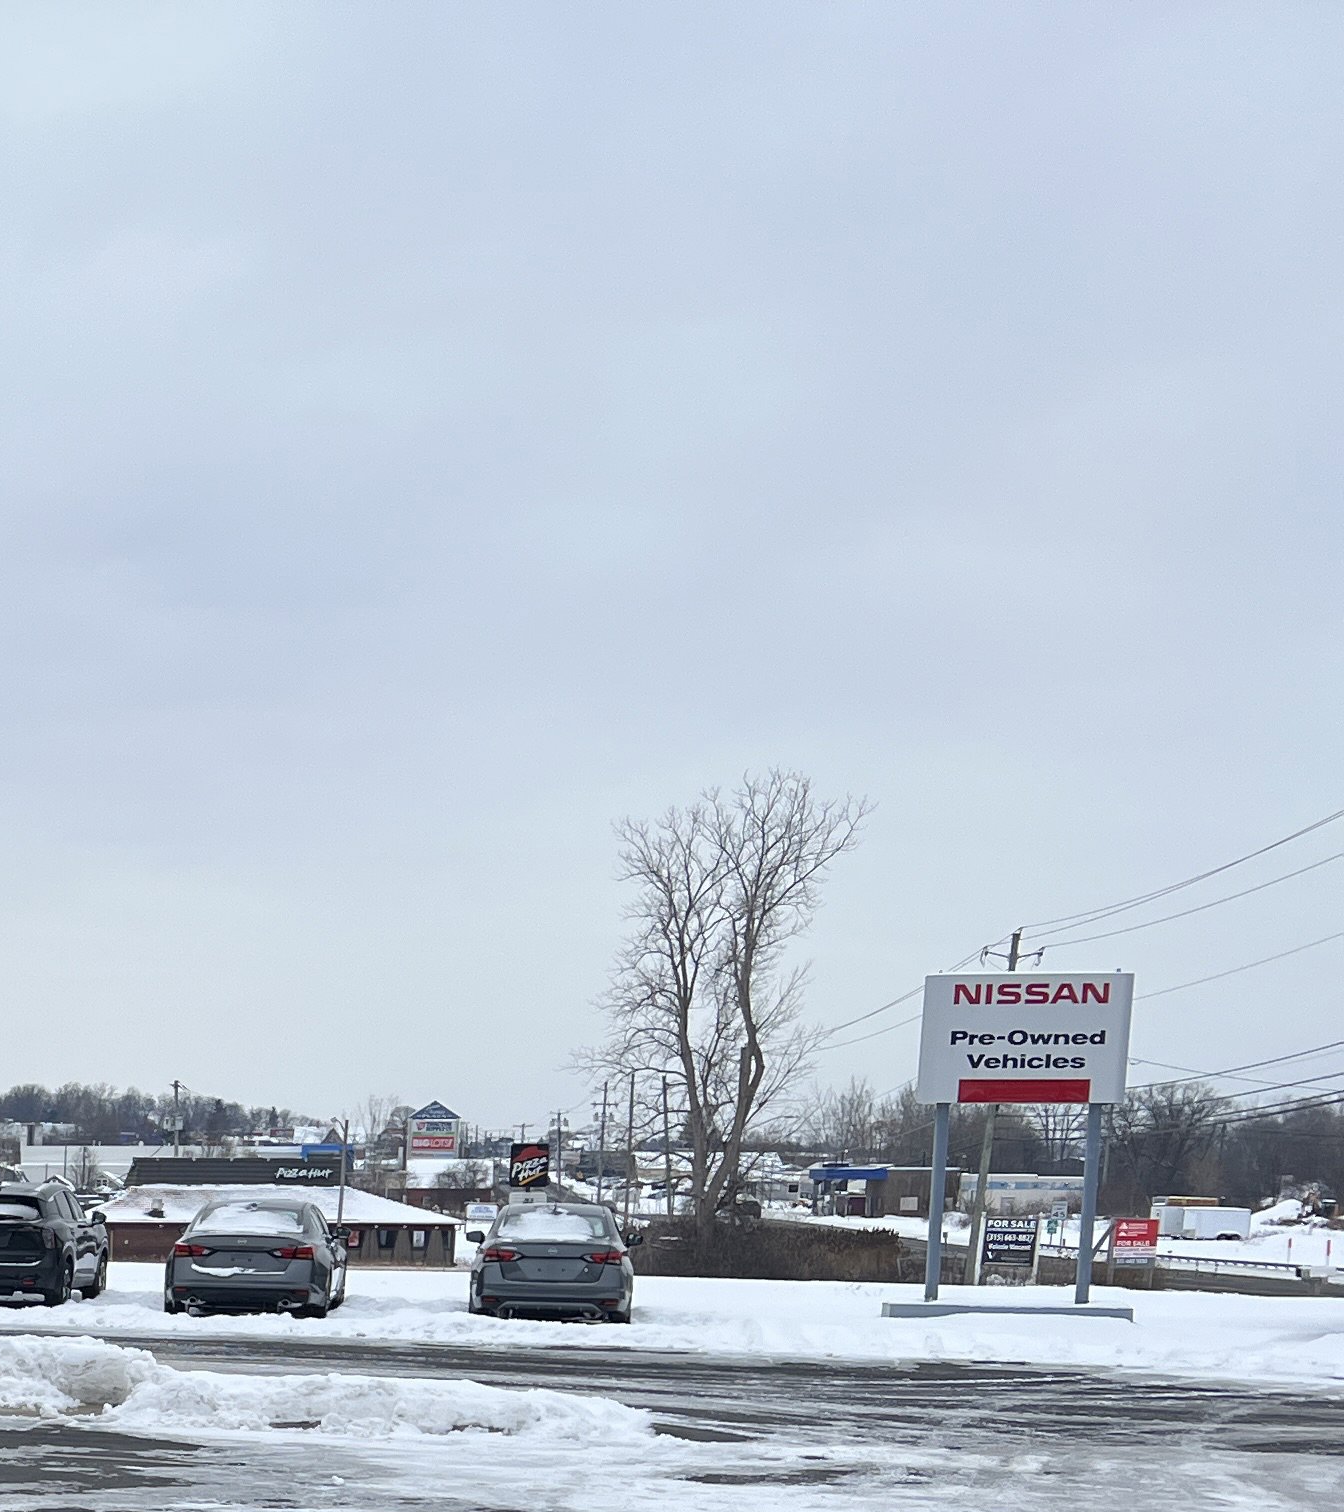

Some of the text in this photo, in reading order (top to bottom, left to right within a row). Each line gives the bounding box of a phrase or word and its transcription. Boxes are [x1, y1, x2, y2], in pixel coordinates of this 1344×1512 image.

[953, 982, 1110, 1005] NISSAN
[949, 1029, 1106, 1046] Pre-Owned
[967, 1053, 1086, 1069] Vehicles
[987, 1220, 1009, 1228] FOR
[1010, 1220, 1037, 1228] SALE
